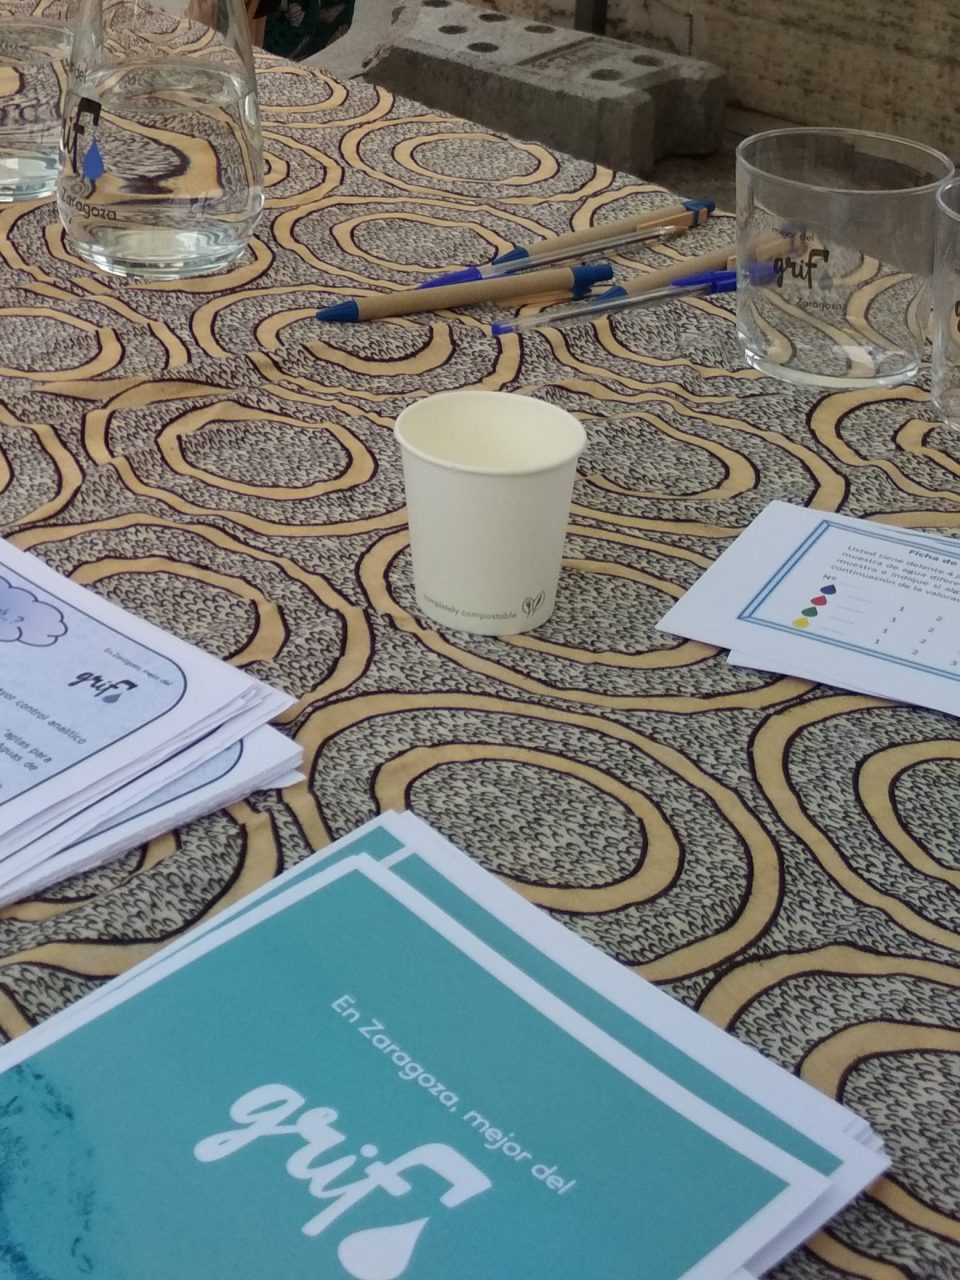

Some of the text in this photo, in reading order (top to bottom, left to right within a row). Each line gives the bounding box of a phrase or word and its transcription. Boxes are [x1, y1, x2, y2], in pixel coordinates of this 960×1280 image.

[61, 187, 117, 220] Zaragoza
[773, 249, 829, 288] grif
[796, 297, 843, 311] Zaragoza
[842, 551, 882, 566] muestra
[847, 545, 877, 557] Usted
[909, 549, 958, 566] Ficha de
[836, 558, 878, 572] muestra
[461, 610, 517, 620] compostable
[72, 668, 139, 701] grif
[13, 699, 51, 721] control
[45, 719, 89, 745] analítico
[331, 993, 576, 1195] En Zaragoza, mejor del
[193, 1083, 492, 1237] grif
